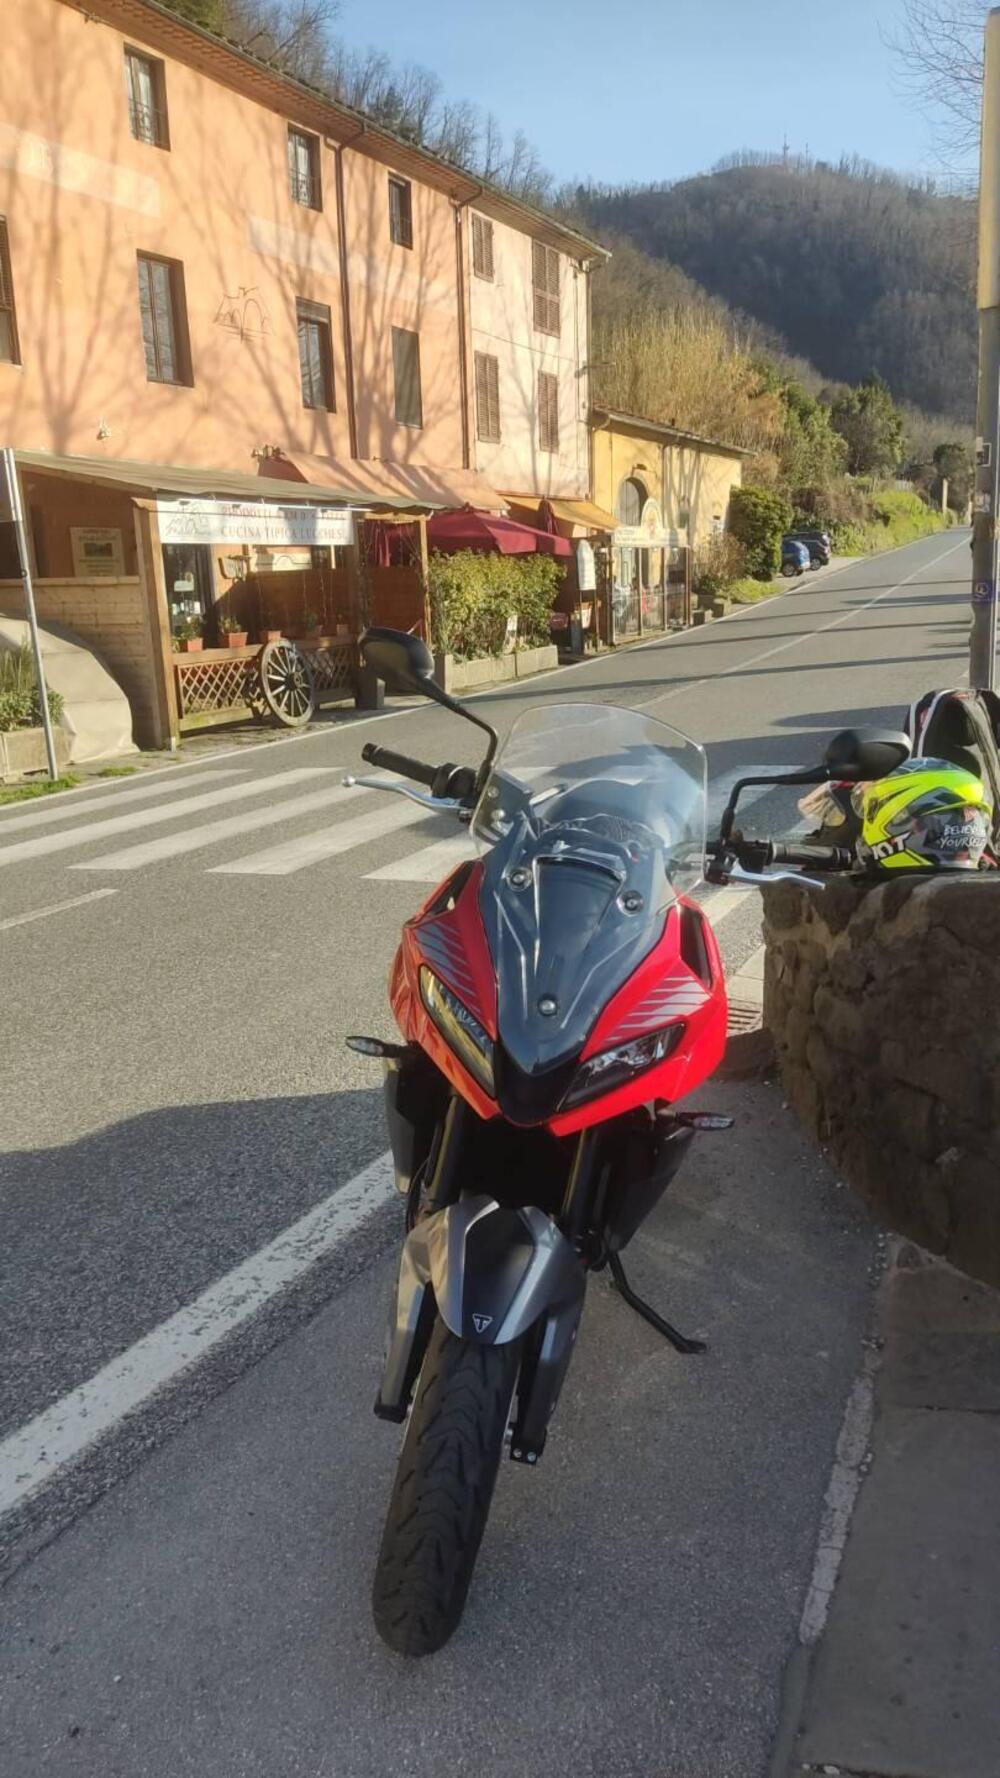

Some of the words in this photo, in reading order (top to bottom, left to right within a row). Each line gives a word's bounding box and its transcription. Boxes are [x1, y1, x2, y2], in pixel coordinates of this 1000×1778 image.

[221, 525, 261, 537] CUCINA
[263, 526, 297, 539] TIPICA
[299, 527, 347, 540] LUCCHES
